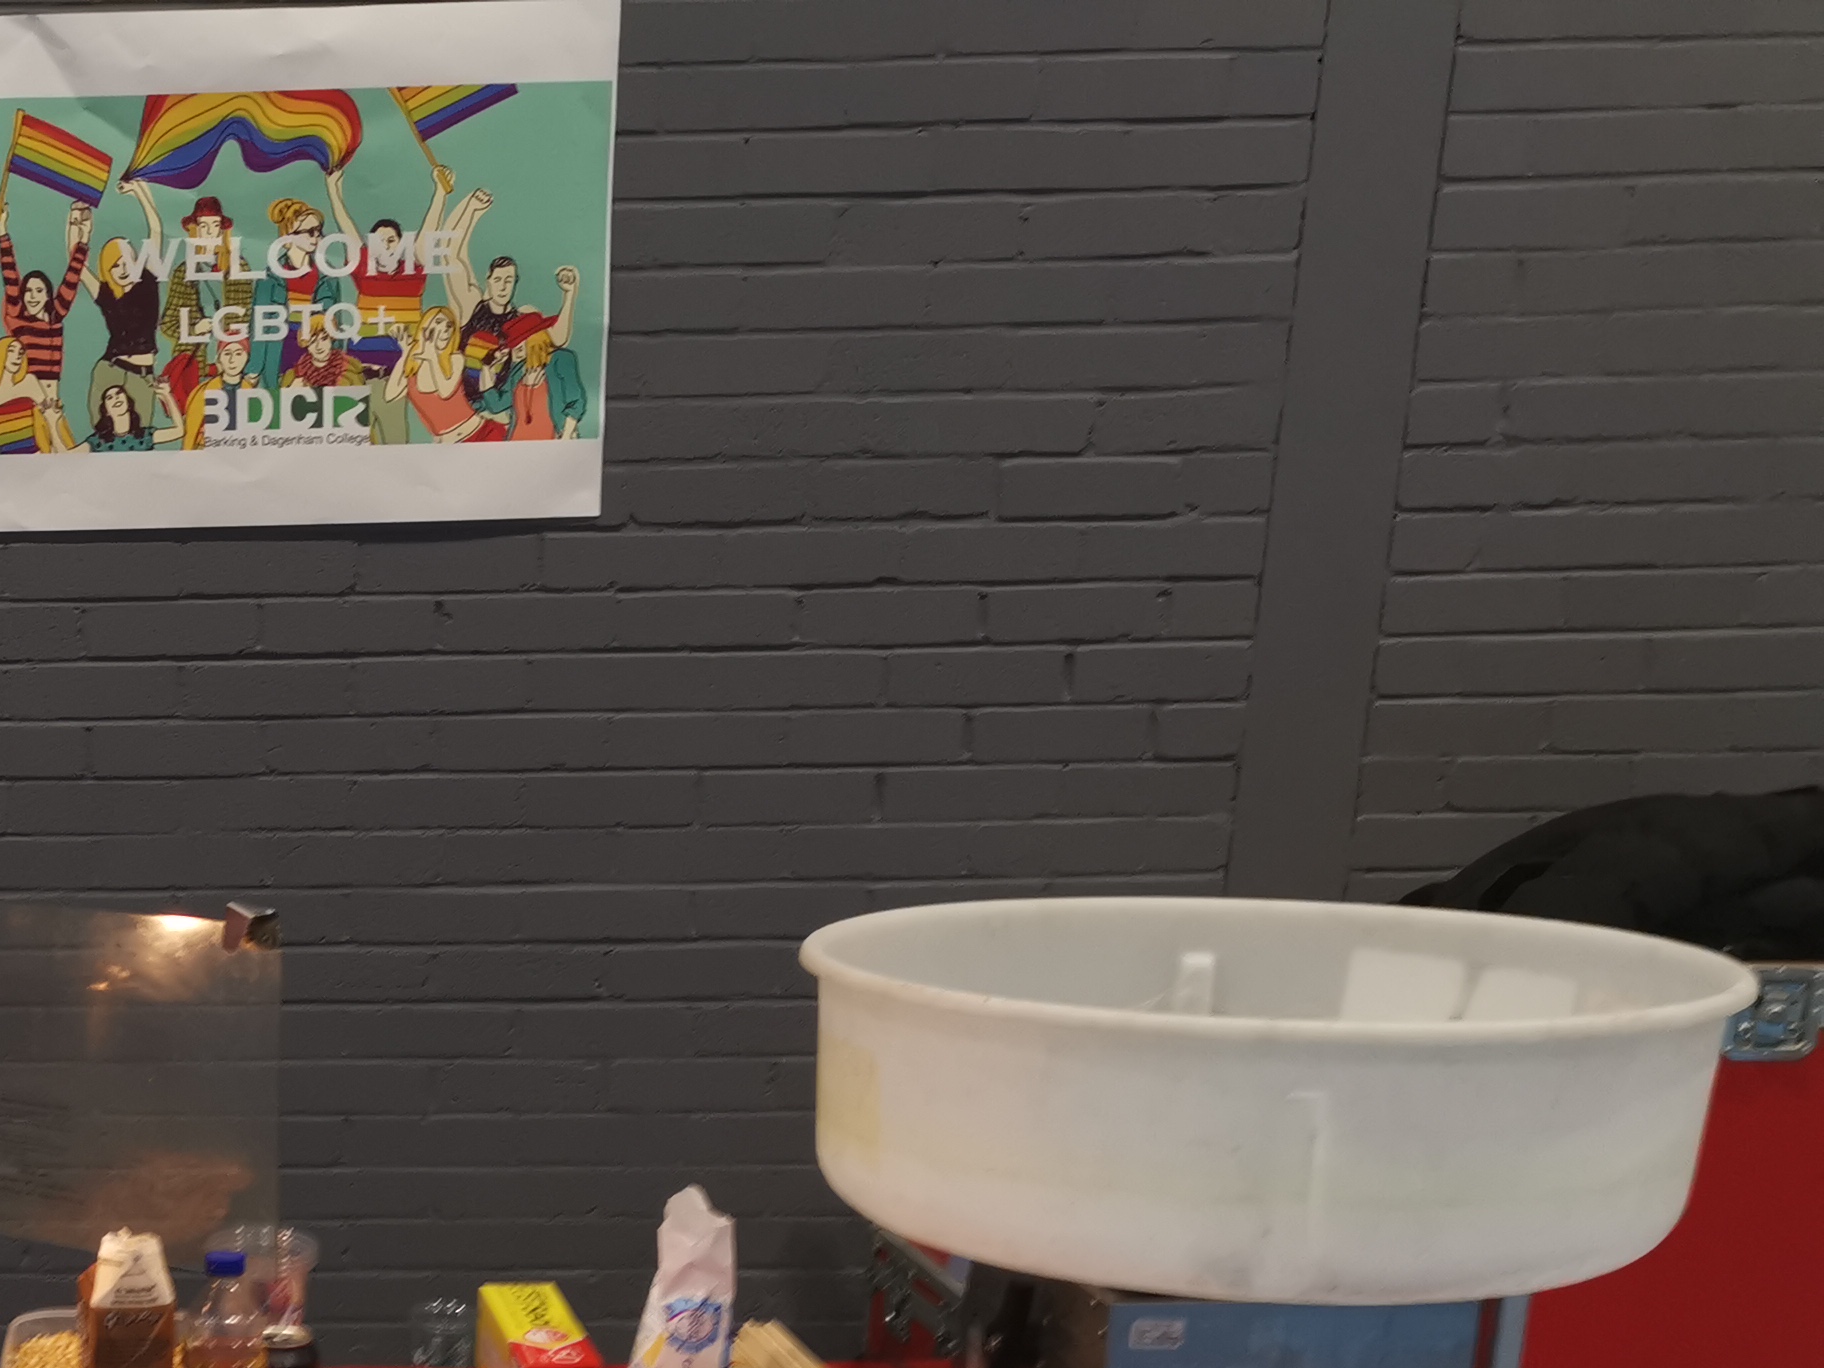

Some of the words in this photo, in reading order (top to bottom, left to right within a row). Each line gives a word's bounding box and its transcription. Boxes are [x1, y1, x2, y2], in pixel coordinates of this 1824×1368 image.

[119, 229, 462, 283] WELCOME
[178, 302, 397, 346] LGBTQ+
[205, 434, 248, 450] Barking
[262, 433, 323, 448] Dagenham
[326, 431, 370, 446] College
